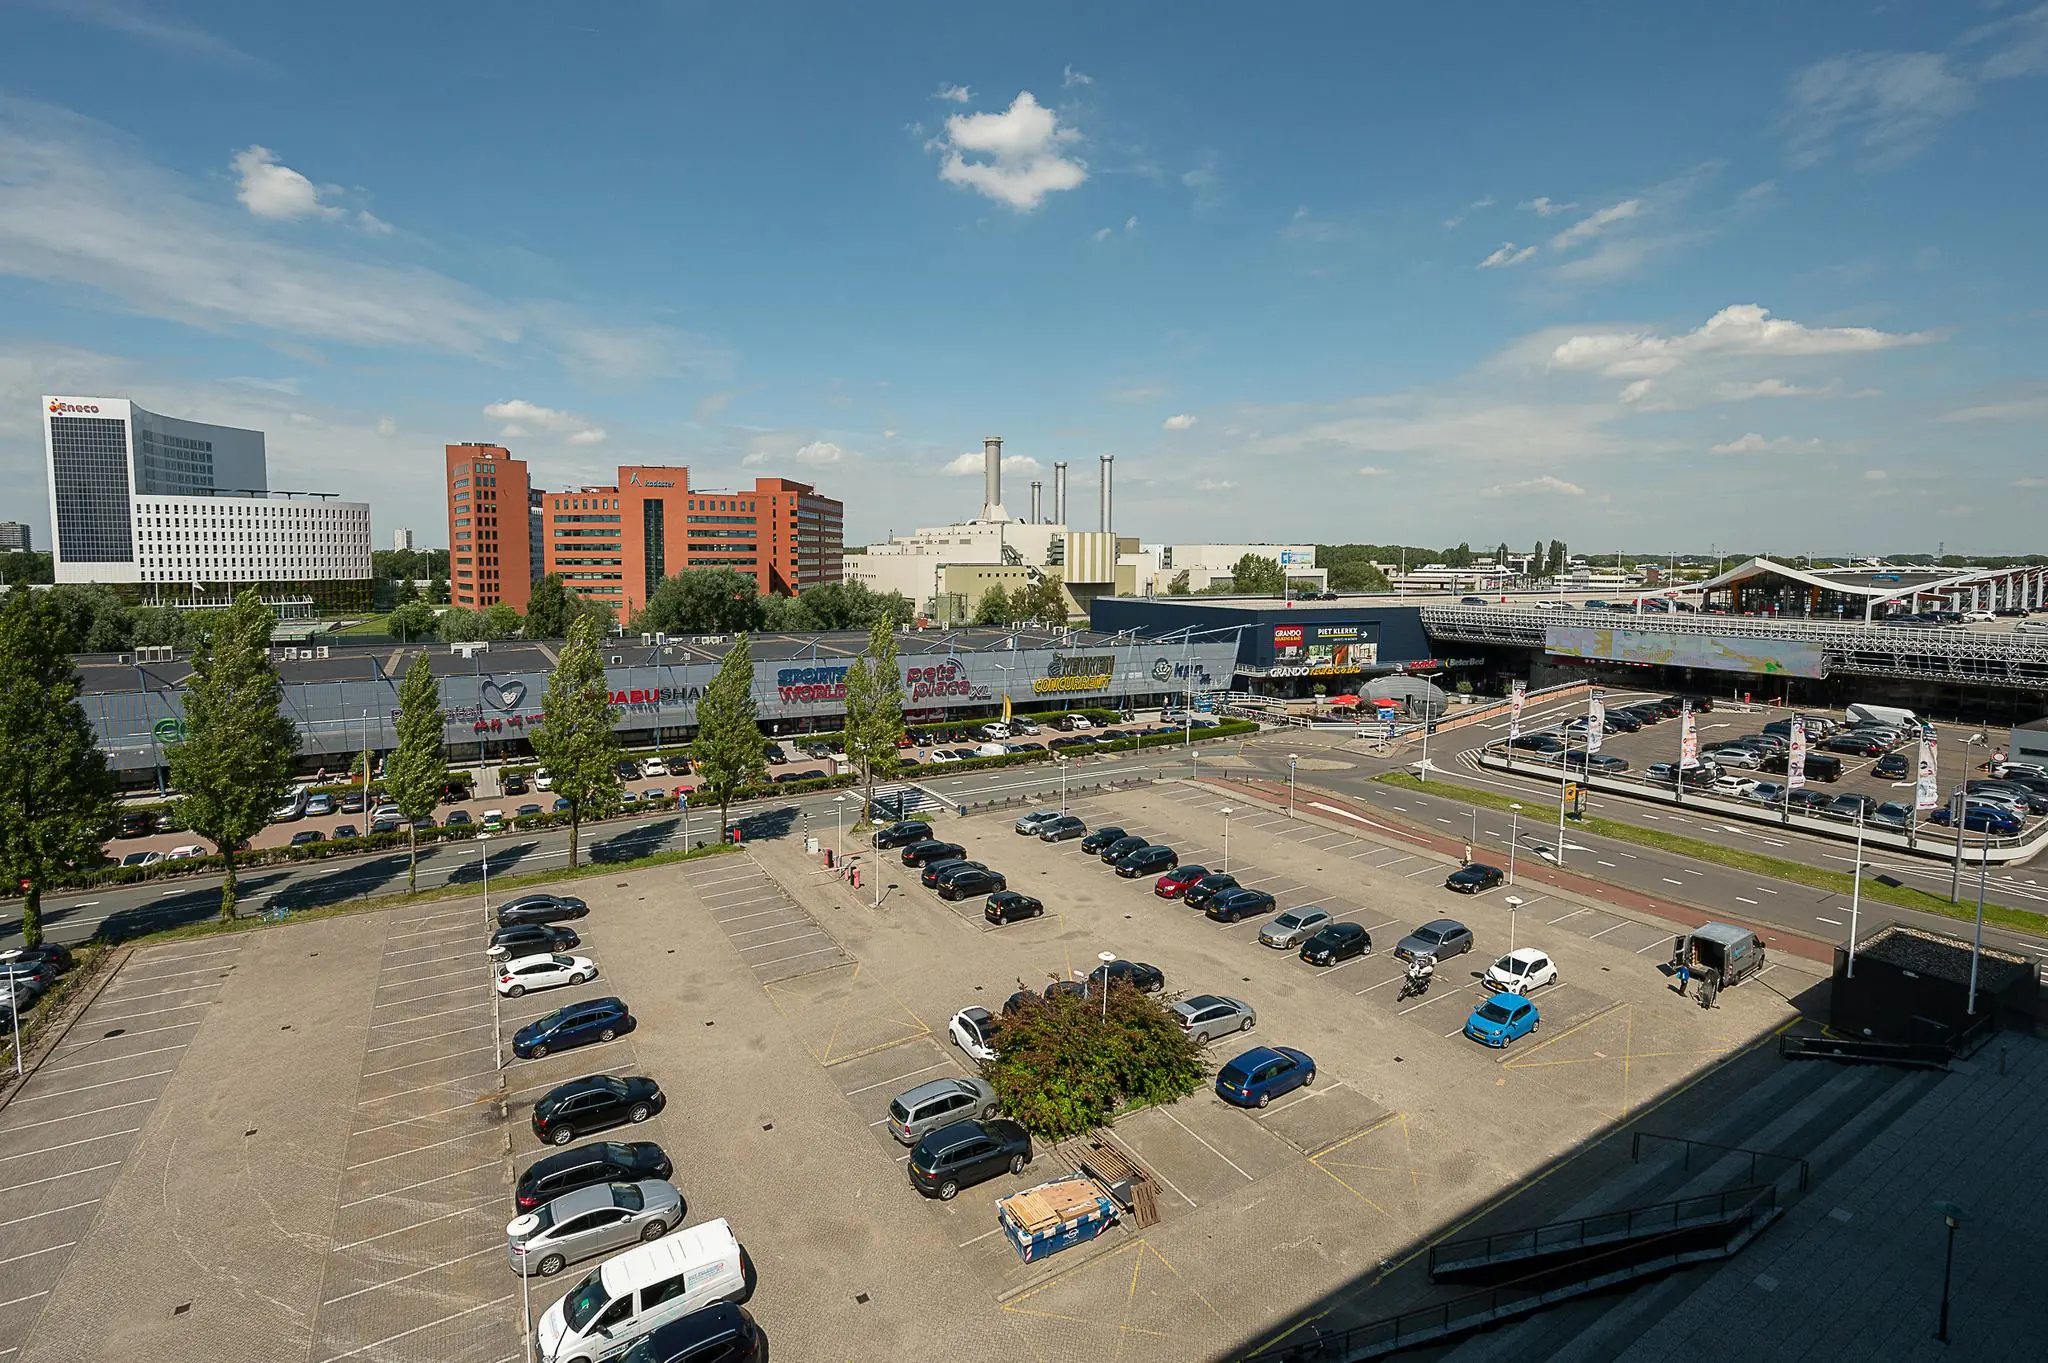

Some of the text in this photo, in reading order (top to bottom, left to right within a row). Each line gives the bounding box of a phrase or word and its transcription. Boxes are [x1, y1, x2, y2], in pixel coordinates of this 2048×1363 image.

[60, 402, 100, 414] Eneco
[1275, 629, 1302, 637] GRANDO
[906, 664, 957, 688] pets
[1173, 662, 1204, 680] kpn
[1270, 666, 1309, 678] GRANDO
[777, 684, 848, 704] WORLD
[912, 680, 992, 702] place XL
